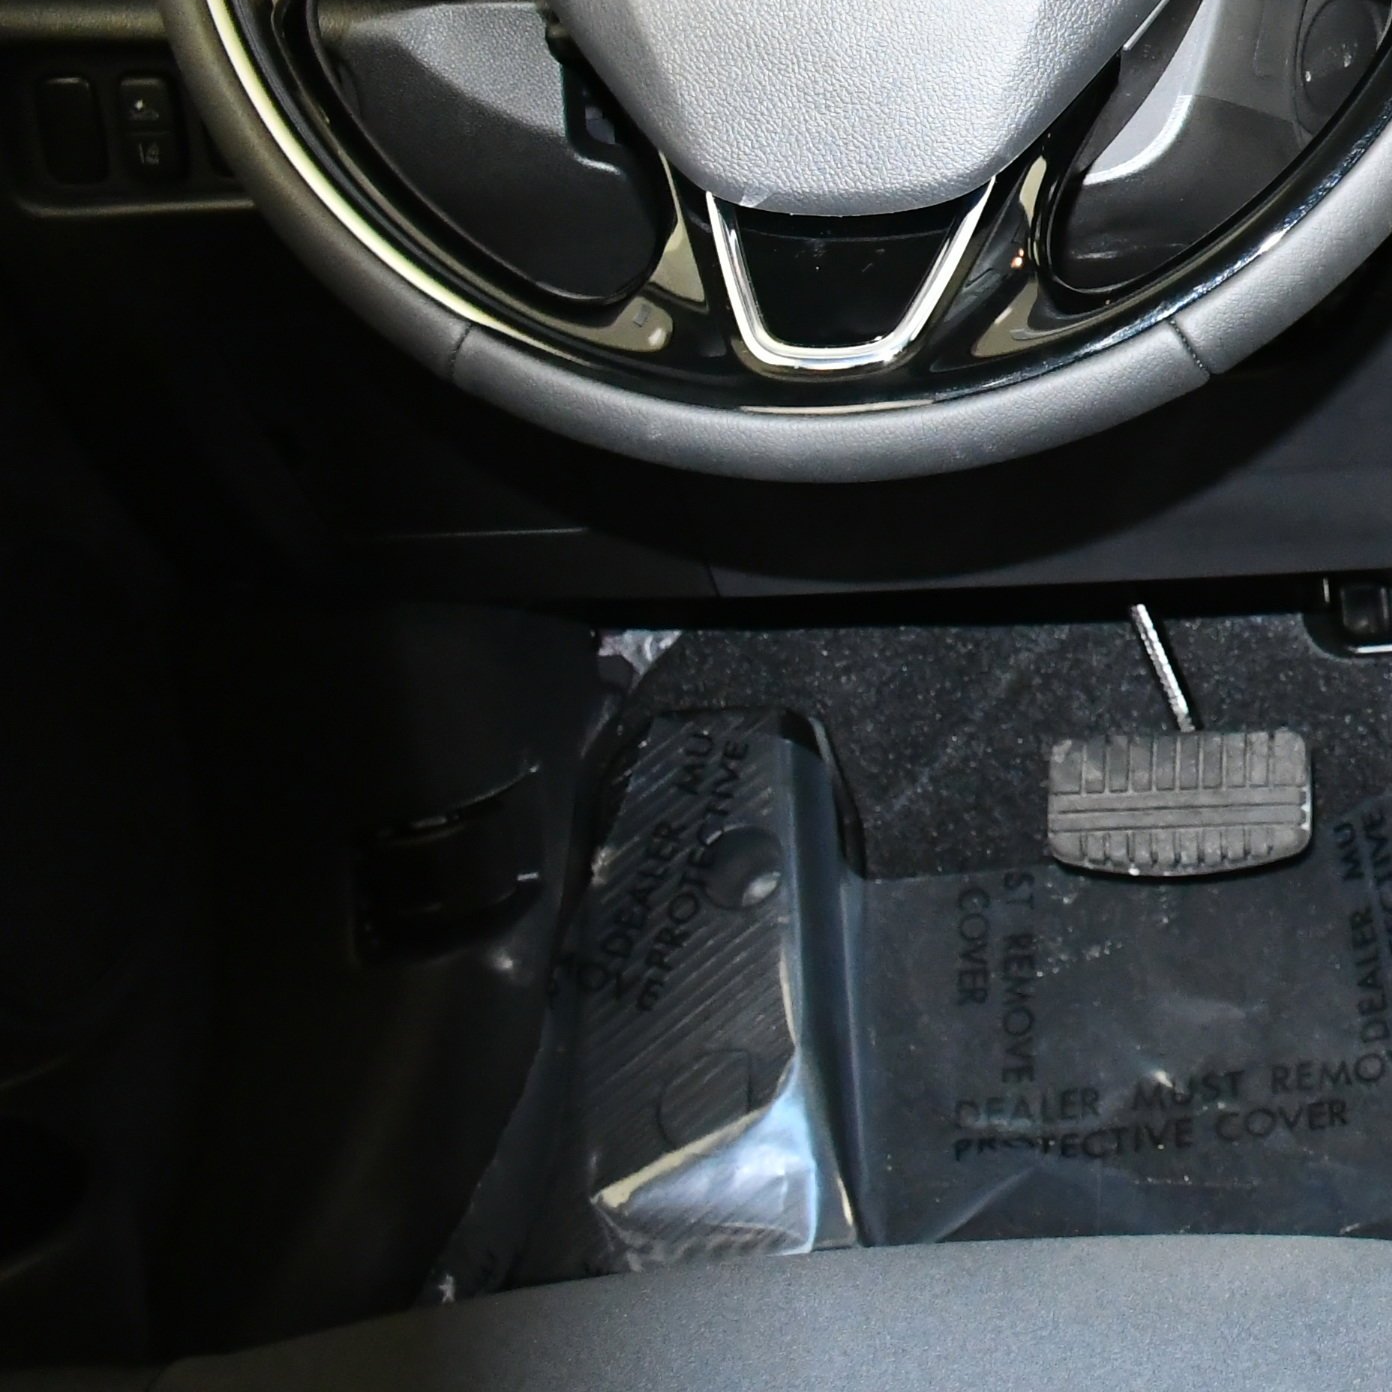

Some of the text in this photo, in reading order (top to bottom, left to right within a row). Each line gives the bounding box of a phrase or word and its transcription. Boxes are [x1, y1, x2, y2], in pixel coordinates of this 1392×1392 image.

[603, 821, 686, 958] DEALER
[644, 739, 749, 971] PROTECTIVE
[956, 887, 990, 1006] COVER
[1001, 933, 1036, 1084] REMOVE
[1350, 908, 1390, 1042] DEALER
[1131, 1069, 1248, 1111] MUST
[1214, 1098, 1350, 1142] COVER
